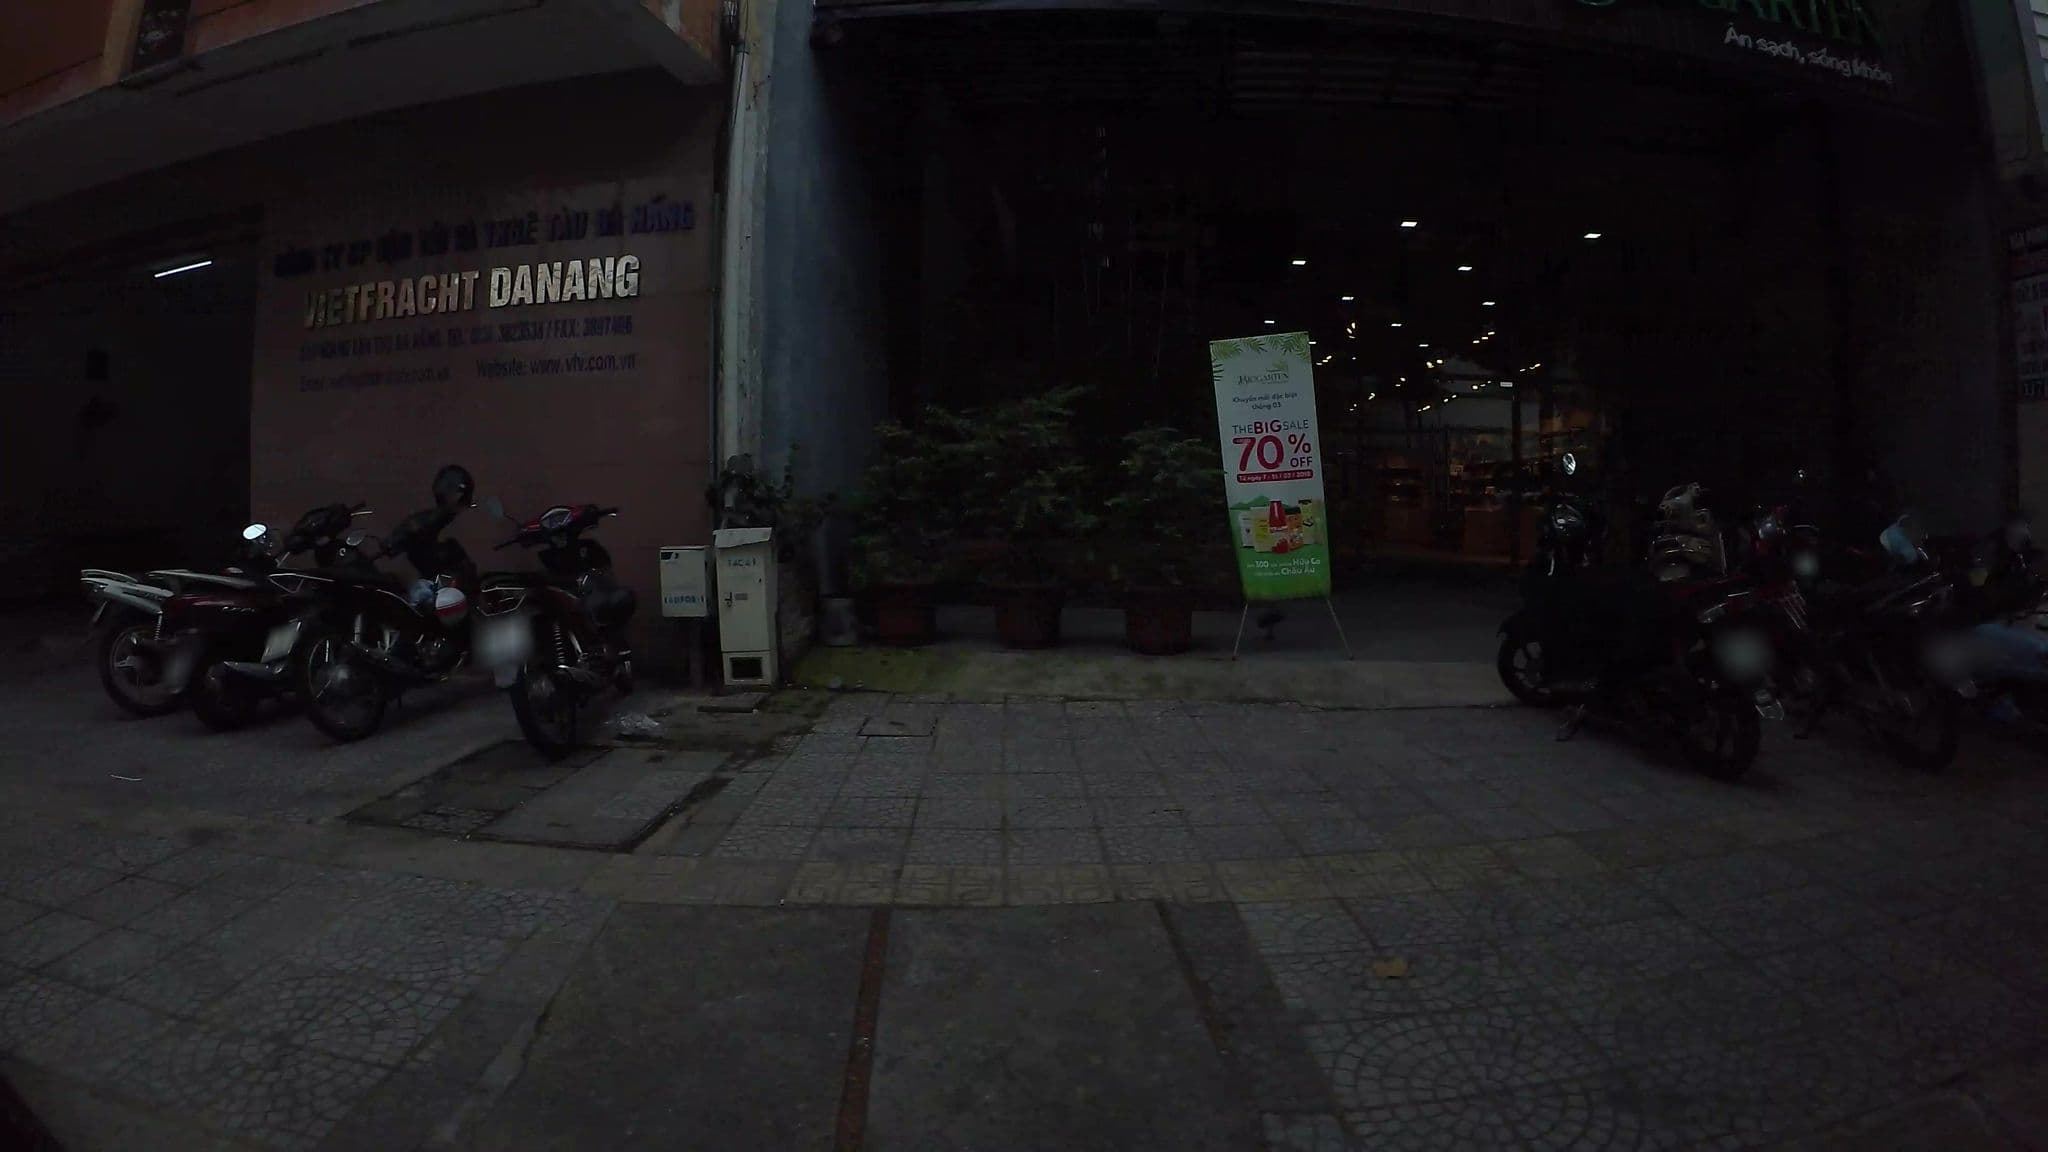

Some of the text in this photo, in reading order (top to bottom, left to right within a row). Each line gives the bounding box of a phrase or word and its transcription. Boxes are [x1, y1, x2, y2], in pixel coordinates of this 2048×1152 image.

[304, 254, 641, 329] VIETFRACHT DANANG
[1232, 435, 1285, 472] 70
[1290, 457, 1312, 468] OFF
